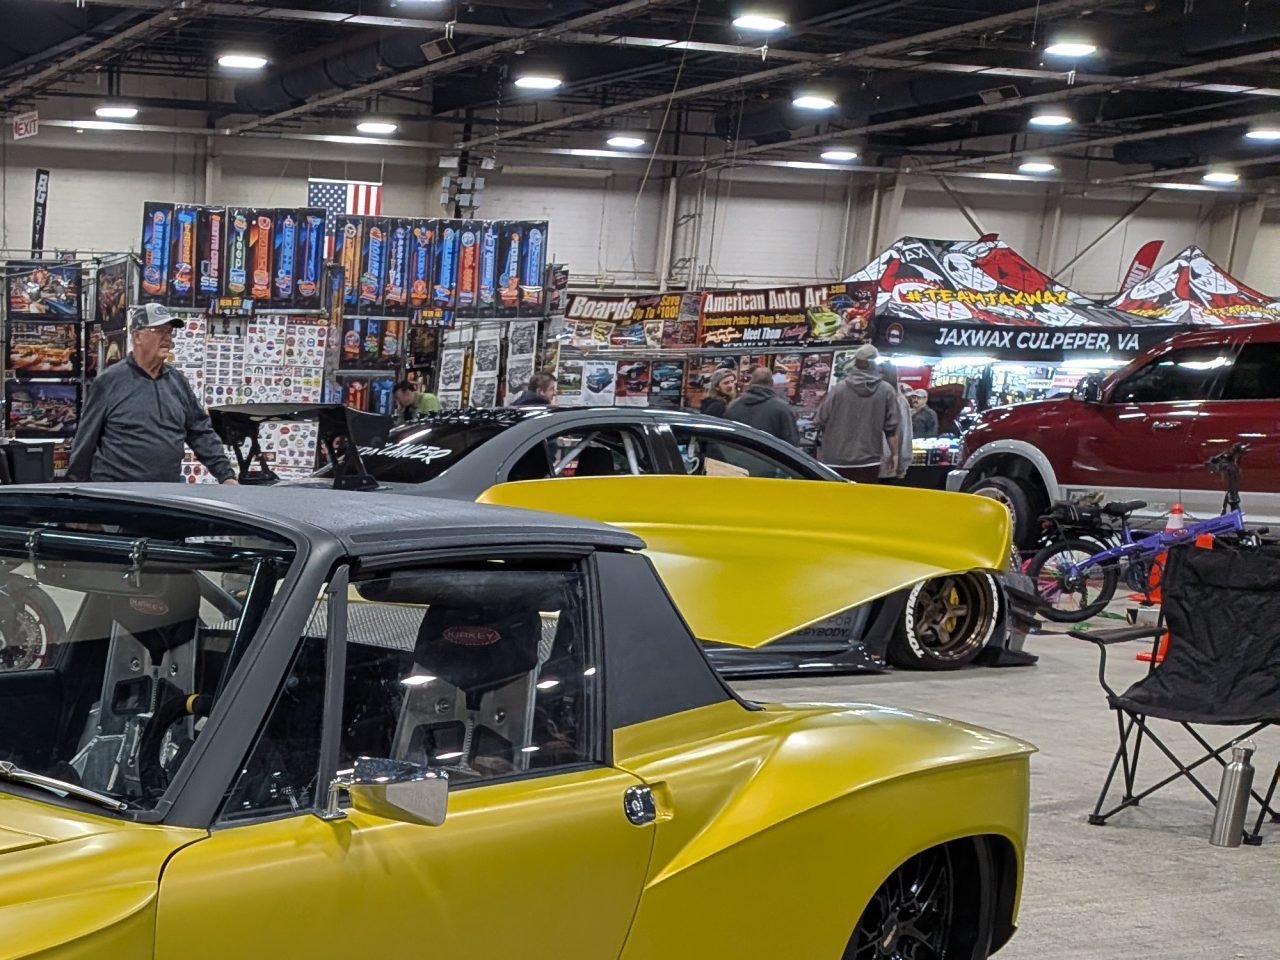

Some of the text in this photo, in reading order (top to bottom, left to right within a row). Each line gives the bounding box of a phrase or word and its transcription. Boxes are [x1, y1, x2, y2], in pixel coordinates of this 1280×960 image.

[18, 119, 38, 137] EXIT
[660, 295, 680, 306] Save
[703, 286, 829, 313] American Auto Art
[569, 295, 635, 322] Boards
[742, 327, 761, 341] Meet
[934, 328, 1140, 352] JAXWAX CULPEPER, VA
[827, 616, 852, 627] FOR
[447, 631, 495, 640] KIRKEY
